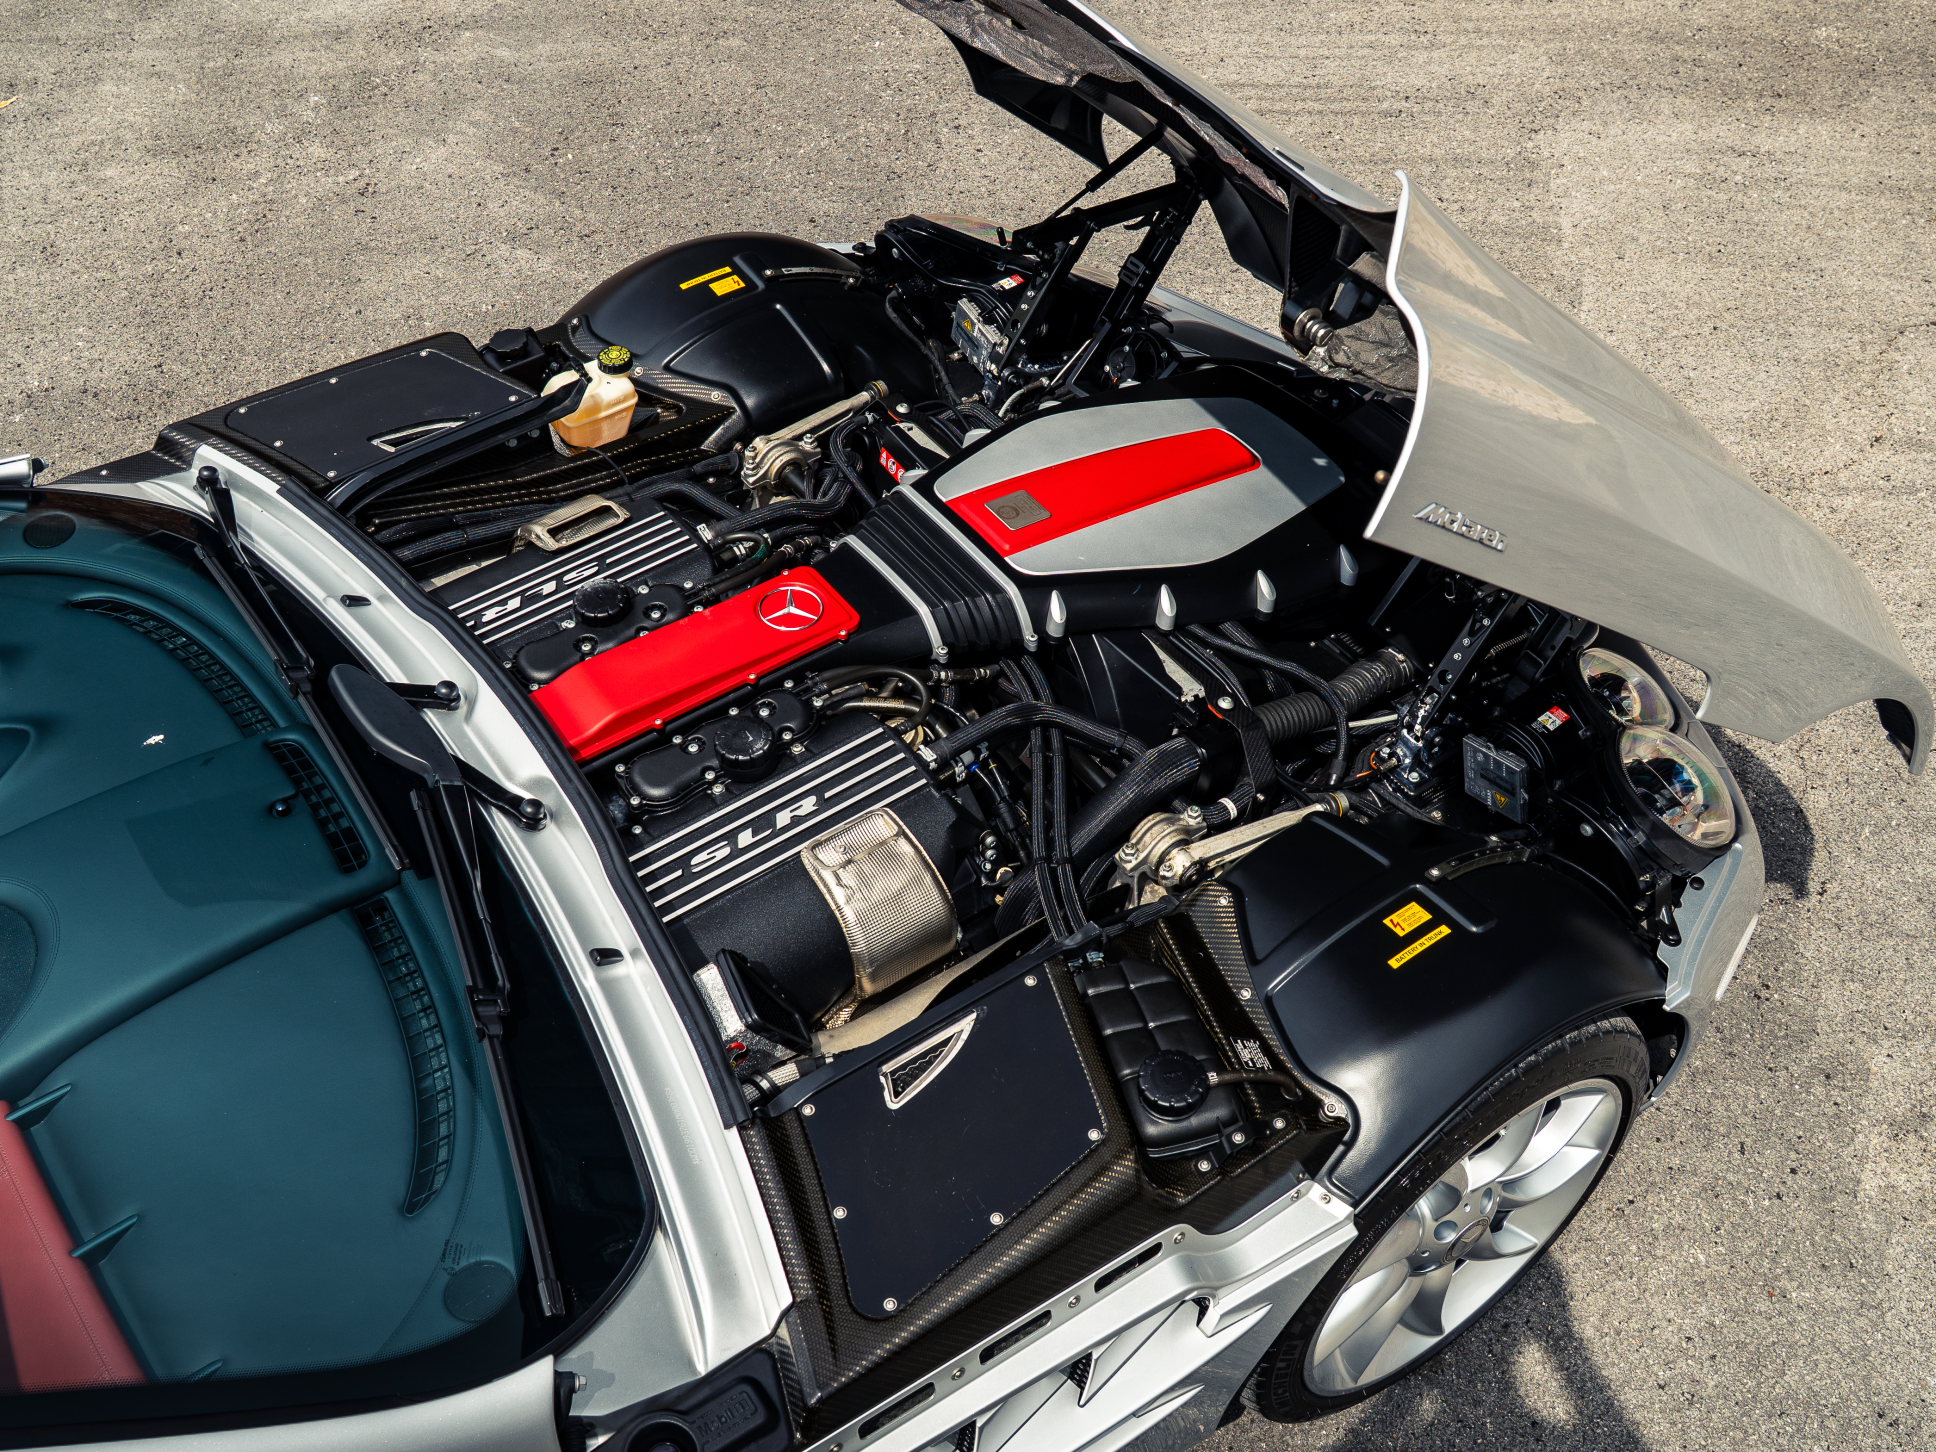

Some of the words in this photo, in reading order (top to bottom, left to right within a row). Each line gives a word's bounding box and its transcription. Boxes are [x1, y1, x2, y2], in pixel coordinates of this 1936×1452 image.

[1412, 502, 1507, 552] McLaren
[481, 561, 599, 623] SLR
[690, 795, 819, 873] SLR
[1394, 946, 1420, 964] BATTERY
[1424, 929, 1445, 943] TRUNK
